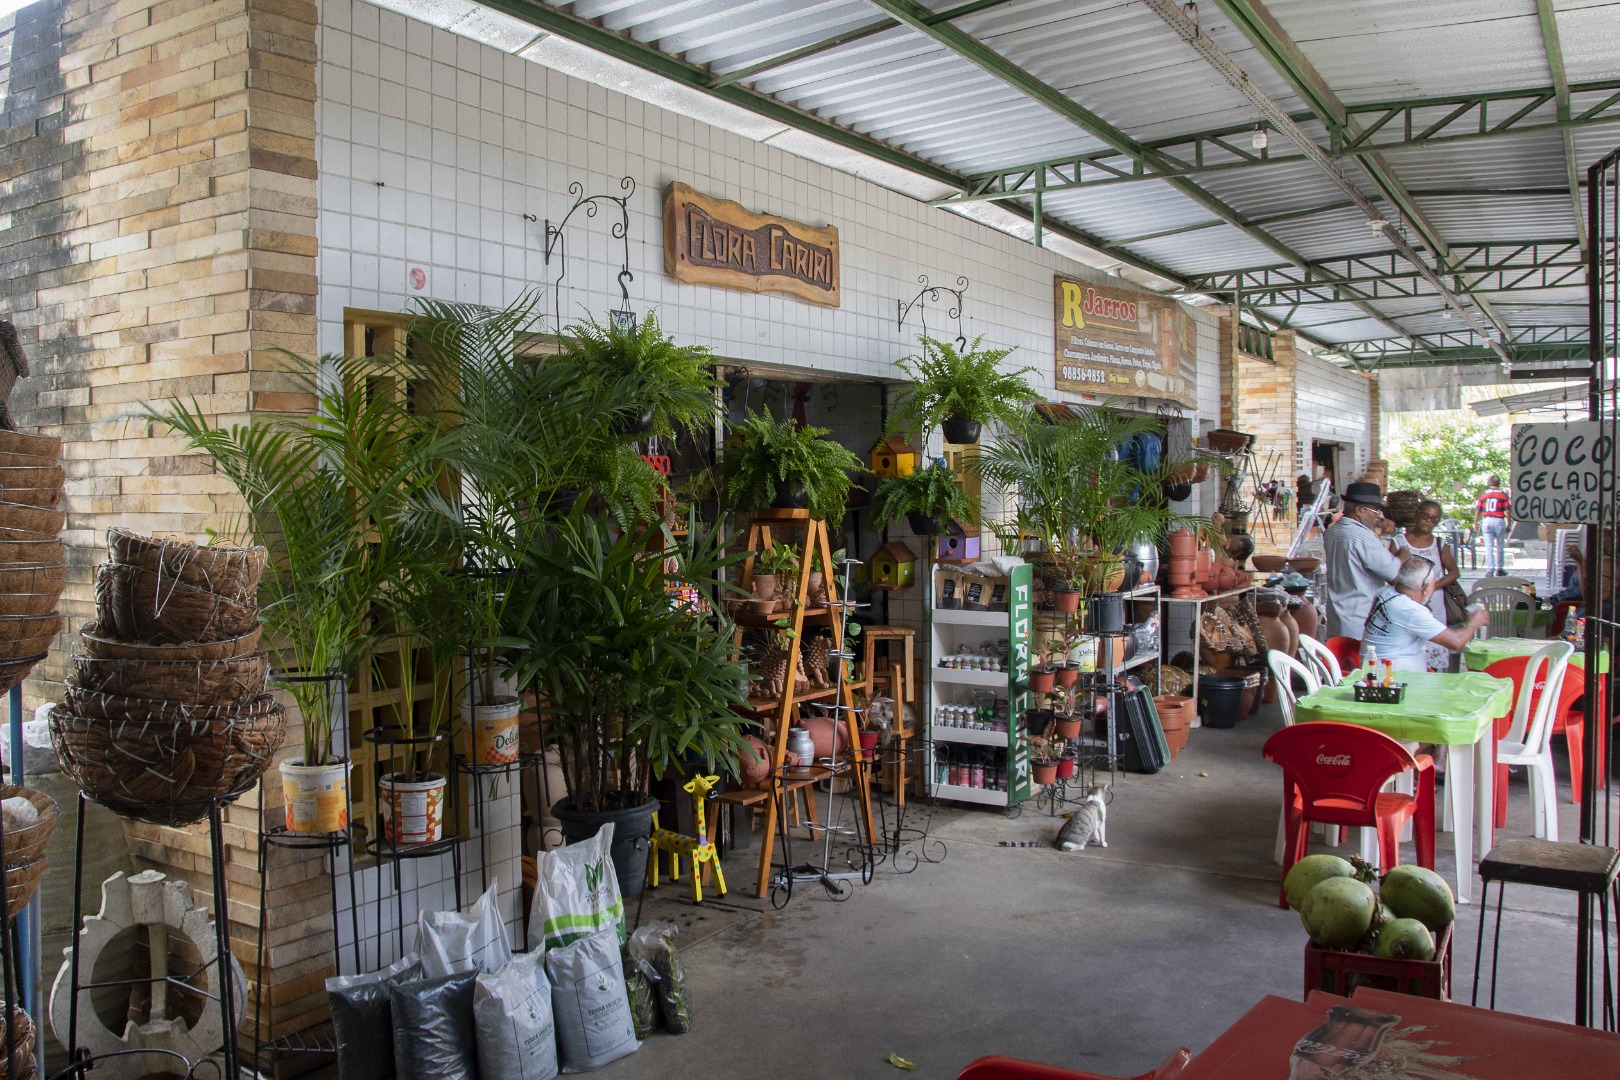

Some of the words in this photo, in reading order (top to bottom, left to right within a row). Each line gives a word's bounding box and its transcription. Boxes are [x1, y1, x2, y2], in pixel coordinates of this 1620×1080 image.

[689, 211, 756, 269] FLORA
[770, 228, 832, 284] CARIRI
[1061, 280, 1086, 330] R
[1084, 287, 1137, 323] Jarros
[1062, 364, 1106, 384] 98856-9852
[1517, 434, 1613, 467] COCO
[1517, 469, 1614, 492] GELADO
[1485, 498, 1498, 512] 10
[1514, 494, 1572, 520] CALDO
[1015, 584, 1029, 683] FLORA
[1315, 753, 1351, 766] Coca-Cola
